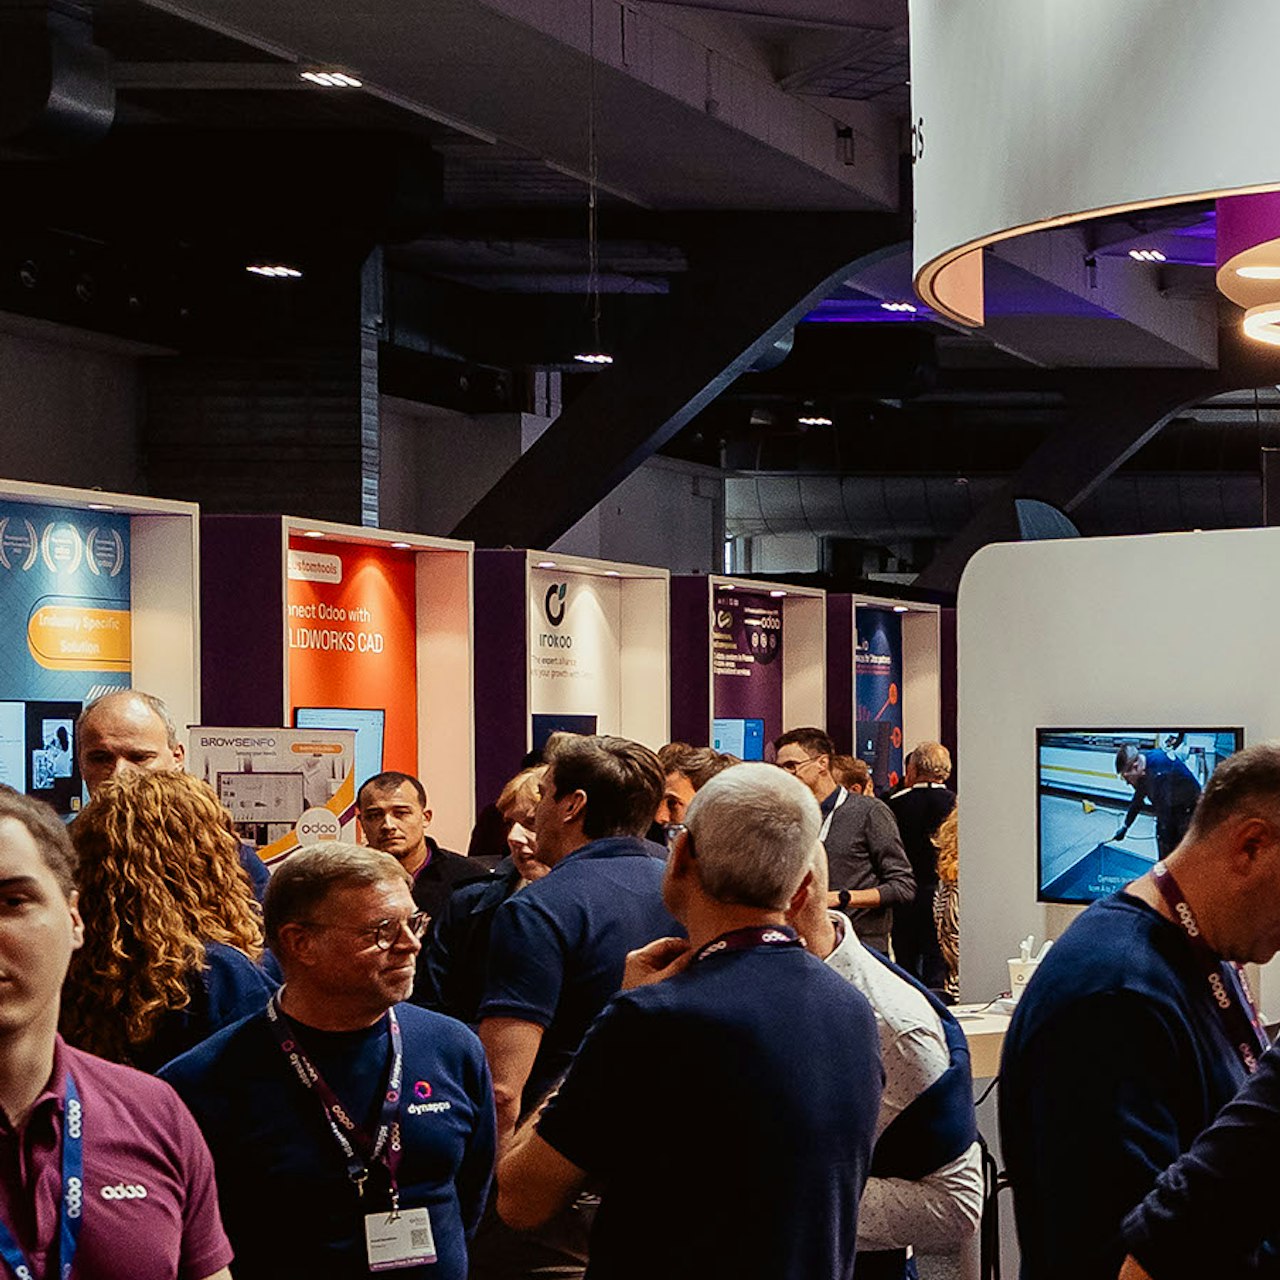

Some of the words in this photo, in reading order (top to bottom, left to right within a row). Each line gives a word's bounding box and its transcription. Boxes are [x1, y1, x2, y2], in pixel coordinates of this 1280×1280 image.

[318, 603, 346, 621] Odoo
[348, 606, 371, 623] with
[83, 615, 121, 632] Specific
[60, 639, 100, 655] Solution
[358, 631, 384, 654] CAD
[200, 737, 276, 748] BROWSEINFO
[301, 823, 336, 835] odoo
[1175, 902, 1199, 937] odoo
[1208, 972, 1231, 1009] odoo
[332, 1104, 355, 1130] odoo
[407, 1100, 451, 1116] dynapps
[67, 1099, 81, 1139] odoo
[66, 1177, 82, 1219] odoo
[100, 1182, 148, 1201] odoo
